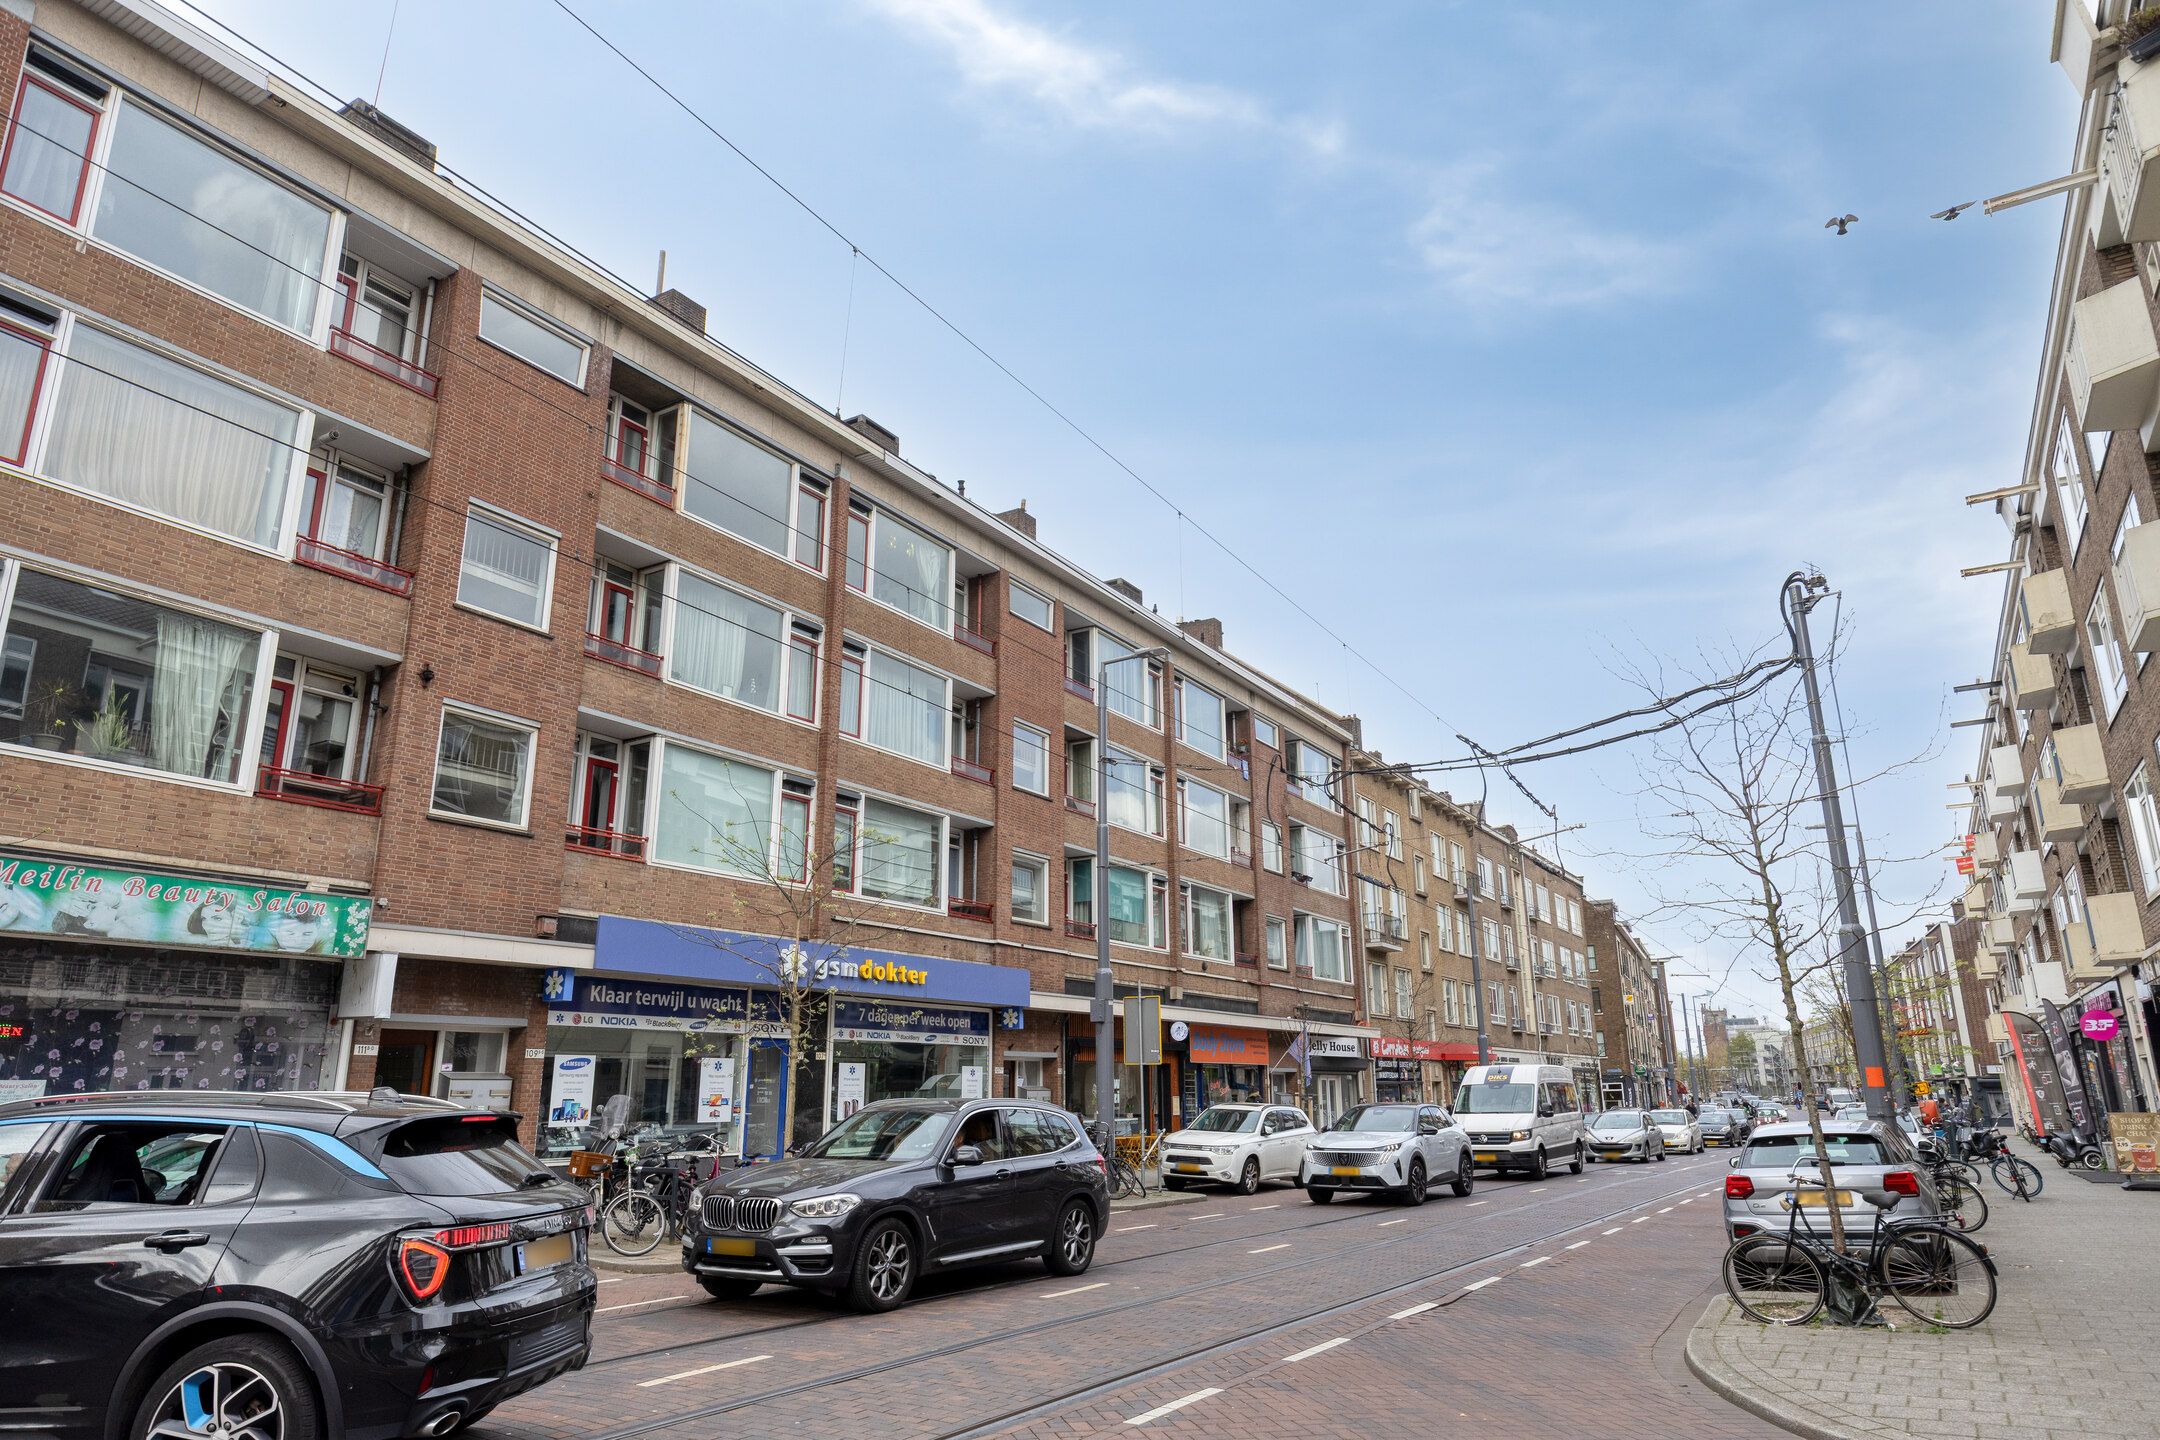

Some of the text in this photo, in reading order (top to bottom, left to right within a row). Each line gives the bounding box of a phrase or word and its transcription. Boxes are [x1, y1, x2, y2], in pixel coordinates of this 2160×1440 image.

[0, 860, 327, 916] Meilin Beauty Salon
[815, 959, 928, 985] gsmdokter
[590, 985, 742, 1011] Klaar terwijl u wacht
[583, 1015, 594, 1024] LG
[600, 1016, 638, 1026] NOKIA
[858, 1008, 865, 1021] 7
[868, 1008, 901, 1027] dagen
[921, 1015, 947, 1027] week
[948, 1017, 971, 1029] open
[0, 1026, 23, 1036] EN
[753, 1023, 786, 1033] SONY
[866, 1032, 891, 1040] NOKIA
[962, 1036, 986, 1045] SONY
[1329, 1041, 1356, 1053] House
